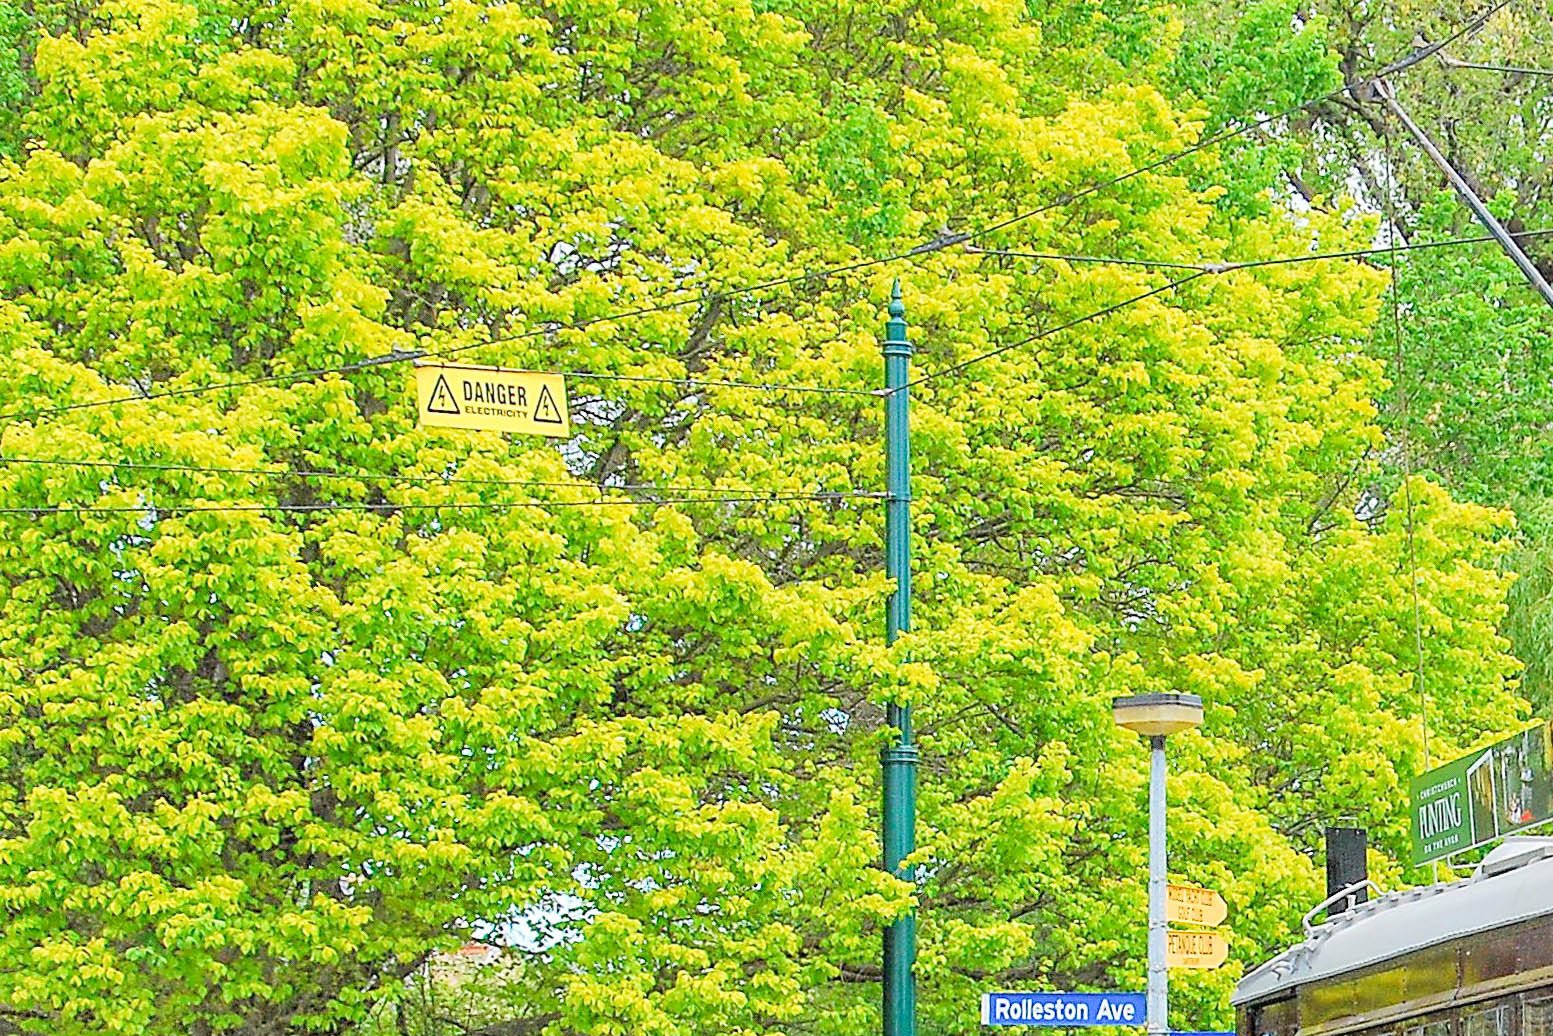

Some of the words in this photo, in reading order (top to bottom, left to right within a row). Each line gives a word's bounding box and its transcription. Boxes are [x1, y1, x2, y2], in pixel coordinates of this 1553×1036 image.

[463, 380, 528, 407] DANGER
[465, 406, 528, 419] ELECTRICITY
[1420, 777, 1457, 800] CHRISTCHURCH
[1419, 792, 1462, 840] PUNTING
[995, 998, 1088, 1021] Rolleston
[1096, 998, 1135, 1021] Ave
